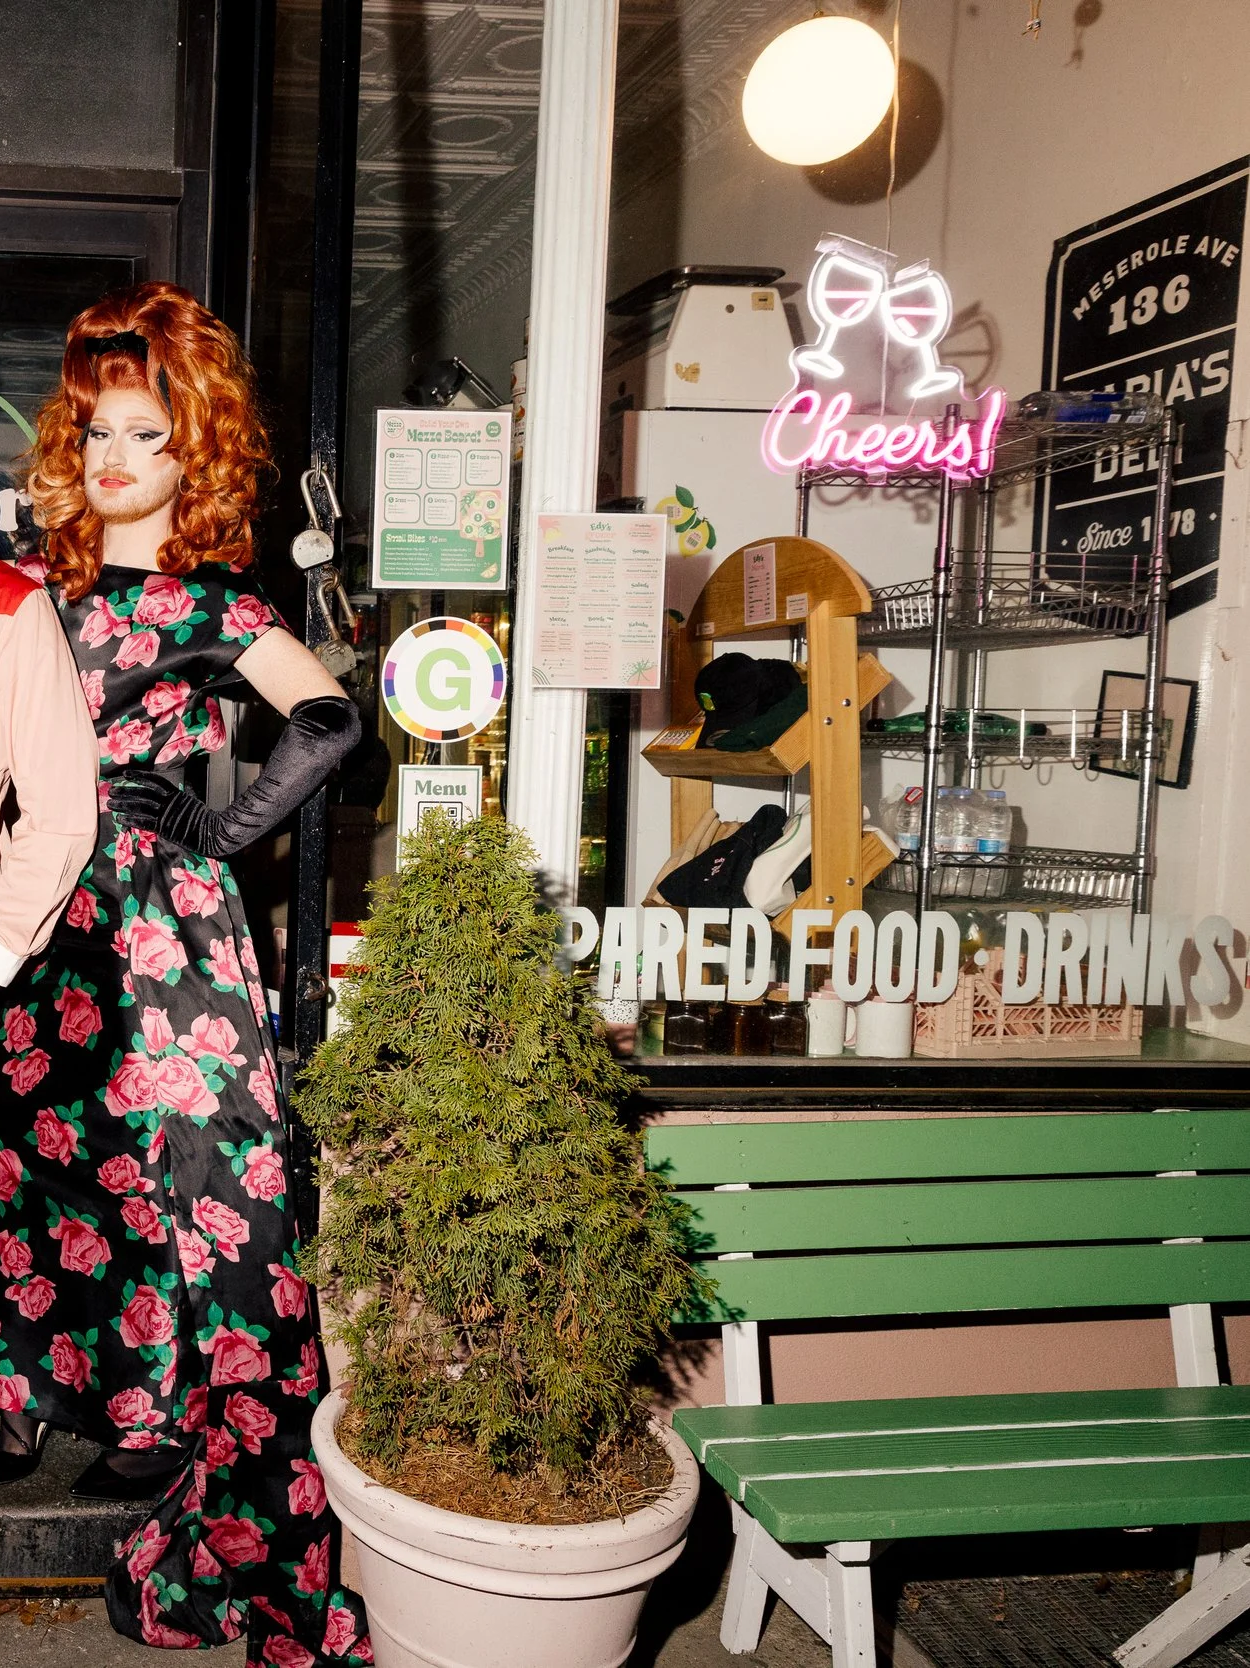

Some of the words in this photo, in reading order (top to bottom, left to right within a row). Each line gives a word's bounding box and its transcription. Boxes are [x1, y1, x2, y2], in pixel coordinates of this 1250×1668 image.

[1072, 235, 1190, 321] MESEROLE
[1194, 236, 1239, 267] AVE
[1108, 274, 1190, 335] 136
[407, 429, 442, 442] Mezze
[444, 430, 481, 443] Board!
[770, 389, 1002, 471] Cheers!
[386, 533, 406, 543] Small
[407, 534, 426, 543] Bites
[590, 521, 612, 531] Edy's
[1077, 522, 1133, 554] Since
[1141, 508, 1196, 542] 178
[548, 545, 574, 553] Breakfast
[585, 546, 616, 555] Sandwiches
[415, 647, 471, 711] G
[414, 779, 467, 796] Menu
[789, 908, 960, 1003] FOOD
[1001, 911, 1234, 1006] DRINKS
